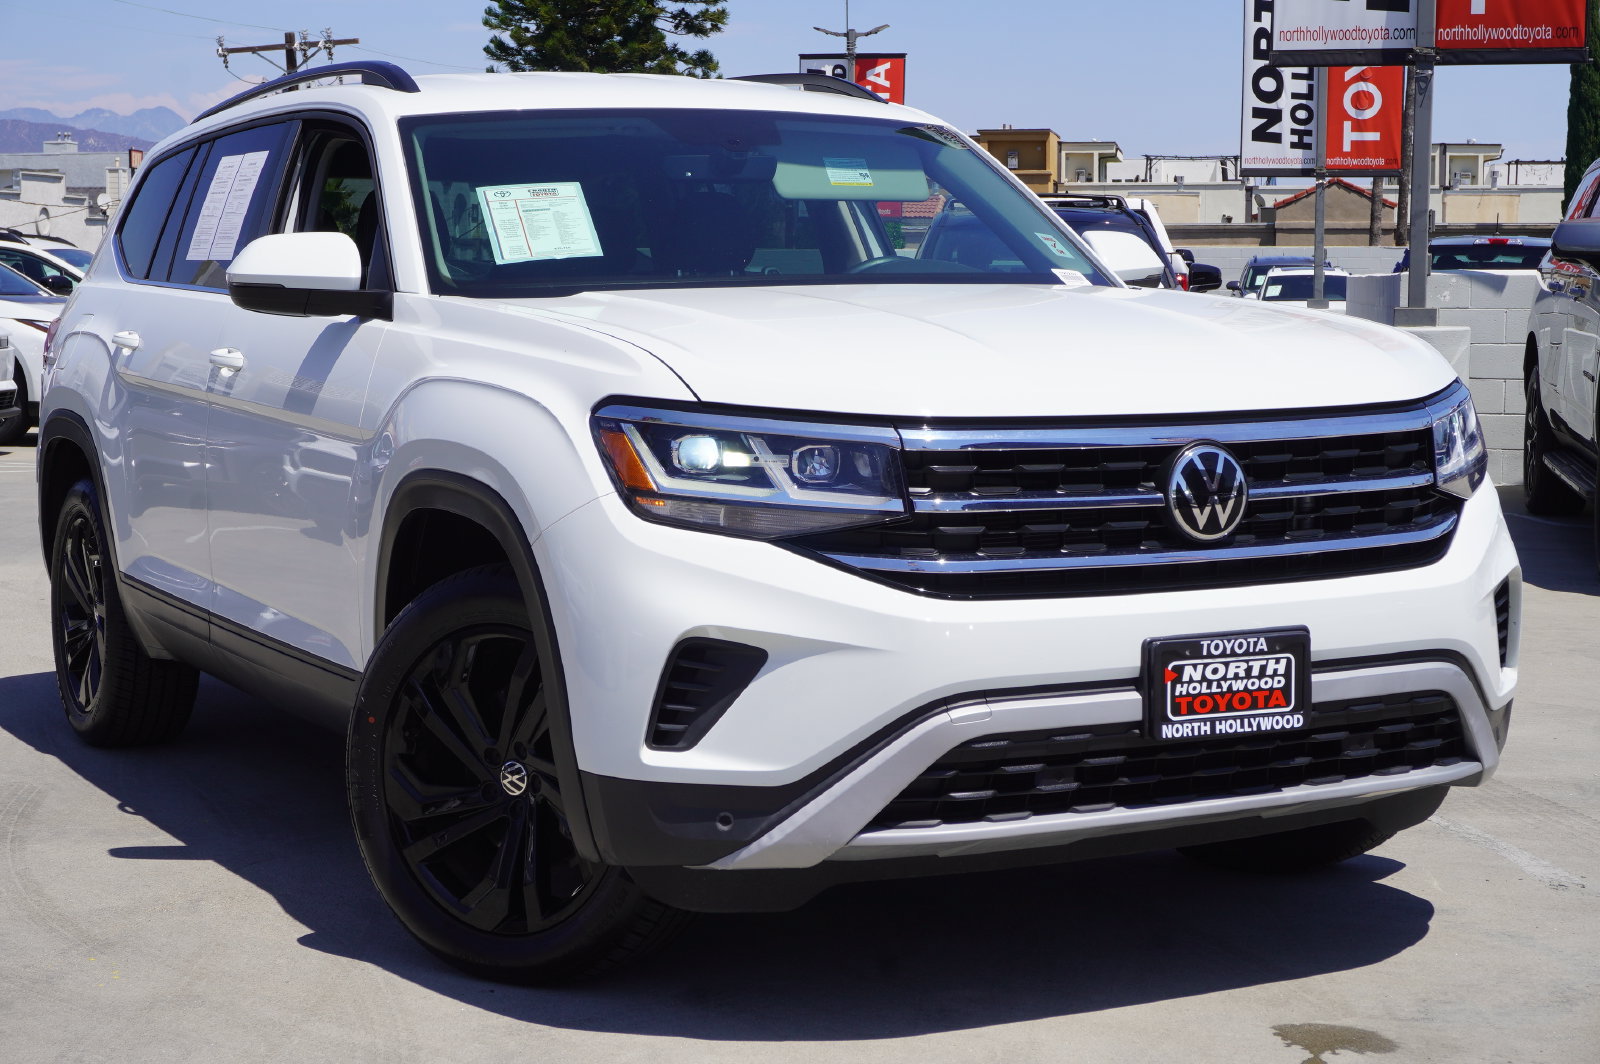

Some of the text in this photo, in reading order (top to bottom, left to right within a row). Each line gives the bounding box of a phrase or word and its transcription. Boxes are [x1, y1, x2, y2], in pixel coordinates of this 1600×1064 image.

[1279, 25, 1416, 44] northhollywoodtoyota.com
[1437, 24, 1579, 44] northhollywoodtoyota.com
[1244, 155, 1316, 167] northhollywoodtoyota.com
[1326, 155, 1398, 168] northhollywoodtoyota.com
[1200, 637, 1268, 656] TOYOTA
[1181, 658, 1287, 682] NORTH
[1174, 676, 1286, 696] HOLLYWOOD
[1175, 689, 1287, 715] TOYOTA
[1161, 714, 1304, 739] NORTH HOLLYWOOD
